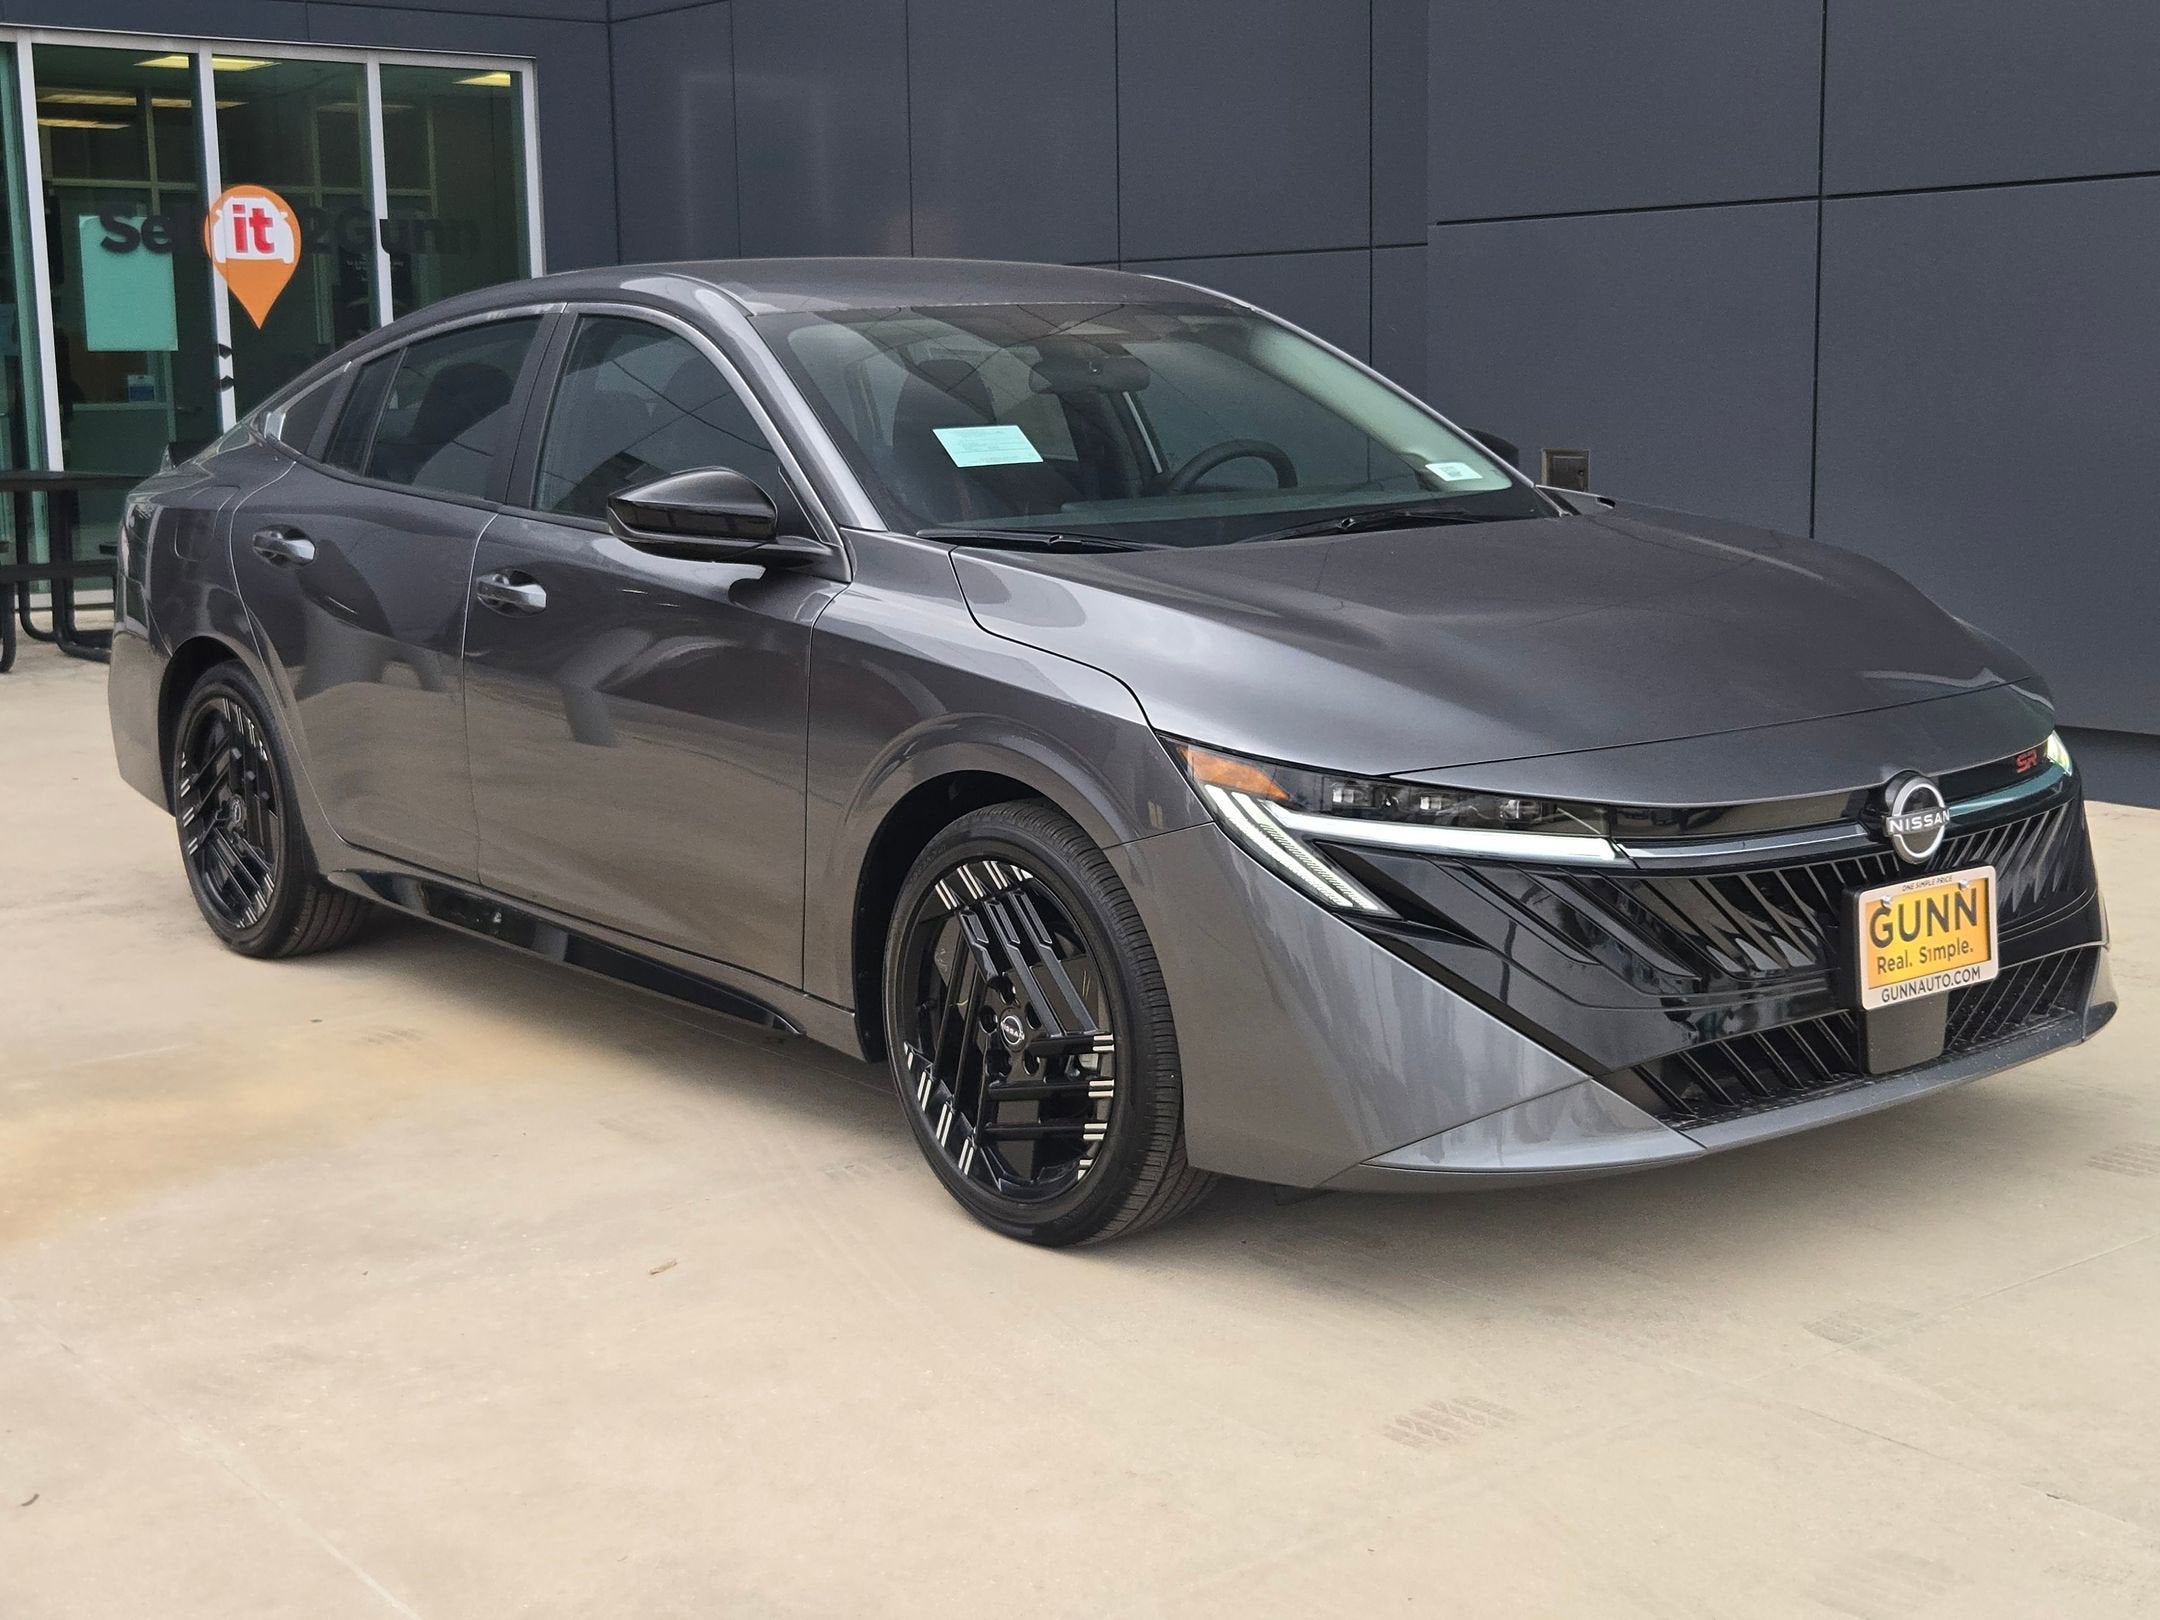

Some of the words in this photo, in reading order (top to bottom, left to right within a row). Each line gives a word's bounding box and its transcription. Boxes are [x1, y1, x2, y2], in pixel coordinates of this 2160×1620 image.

[232, 204, 275, 254] it
[2016, 749, 2038, 774] SR
[1889, 809, 1950, 834] NISSAN
[1869, 888, 1978, 949] GUNN
[1876, 950, 1913, 975] Real.
[1881, 966, 1981, 1003] GUNNAUTO.COM
